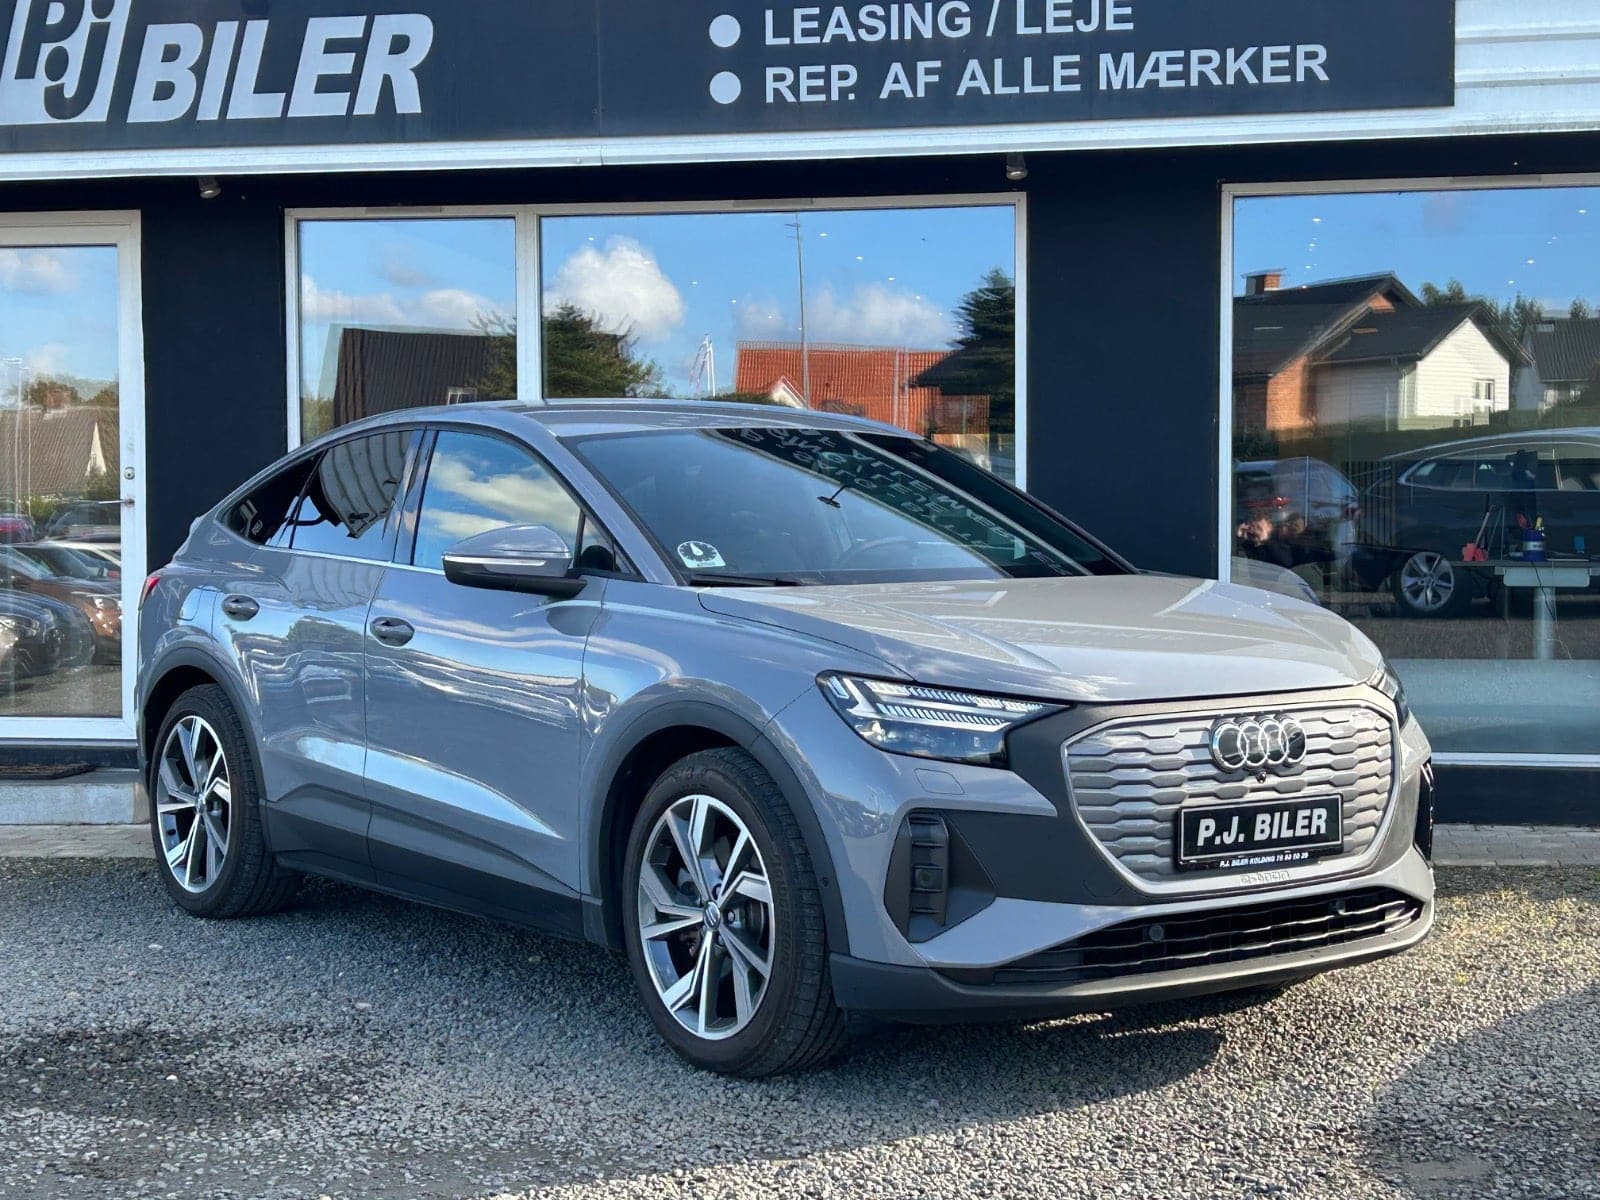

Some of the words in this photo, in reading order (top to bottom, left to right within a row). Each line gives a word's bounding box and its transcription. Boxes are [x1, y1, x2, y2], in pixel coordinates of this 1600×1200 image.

[764, 0, 971, 46] LEASING
[985, 0, 1000, 37] /
[1015, 0, 1135, 35] LEJE
[126, 13, 434, 123] BILER
[765, 65, 856, 104] REP.
[879, 58, 940, 100] AF
[956, 54, 1082, 97] ALLE
[1099, 43, 1330, 91] MÆRKER
[1197, 815, 1245, 847] P.J.
[1253, 807, 1328, 841] BILER
[1231, 858, 1249, 867] BILER
